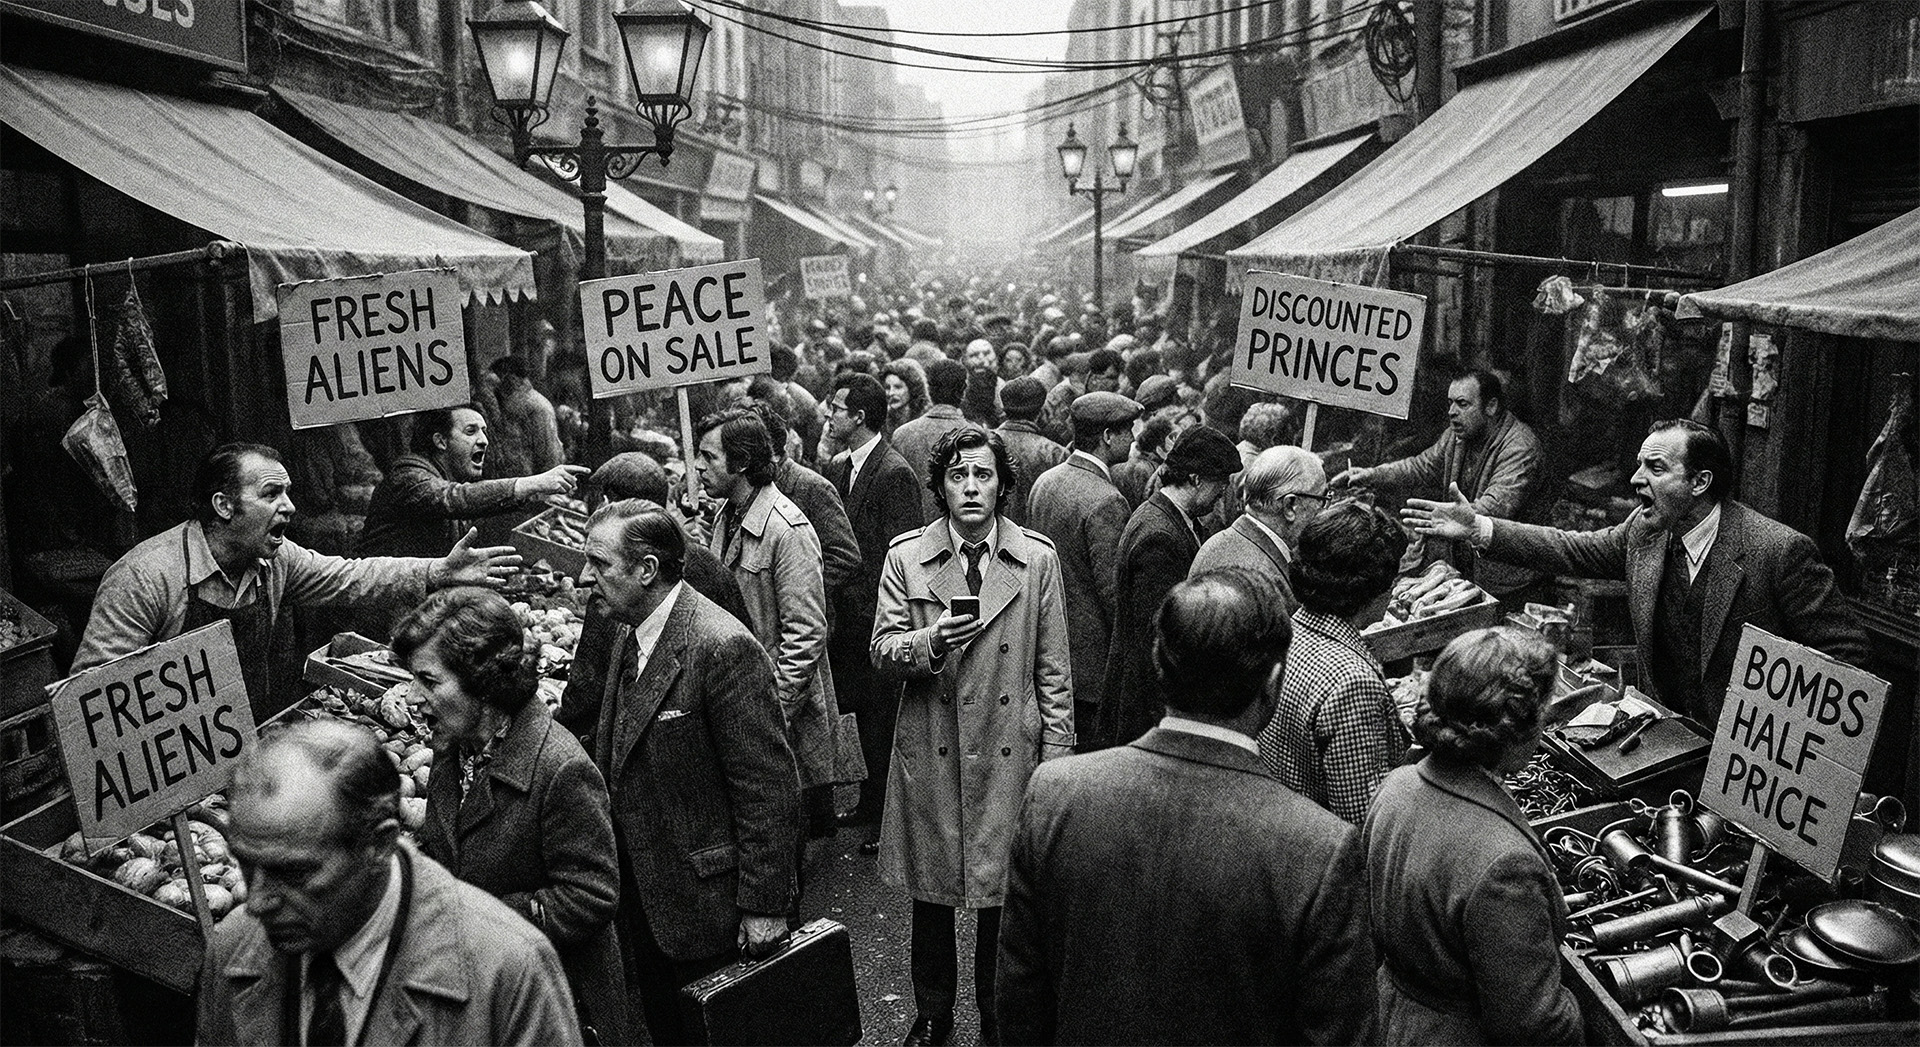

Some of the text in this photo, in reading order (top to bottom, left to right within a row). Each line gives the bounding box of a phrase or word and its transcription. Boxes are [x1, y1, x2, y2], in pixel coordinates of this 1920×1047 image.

[310, 287, 436, 345] FRESH
[602, 272, 750, 337] PEACE
[1252, 286, 1412, 341] DISCOUNTED
[304, 339, 454, 405] ALIENS
[600, 326, 758, 384] ON SALE
[1247, 328, 1400, 396] PRINCES
[78, 648, 216, 750] FRESH
[1743, 645, 1869, 738] BOMBS
[94, 704, 244, 823] ALIENS
[1730, 699, 1826, 775] HALF
[1721, 753, 1828, 847] PRICE
